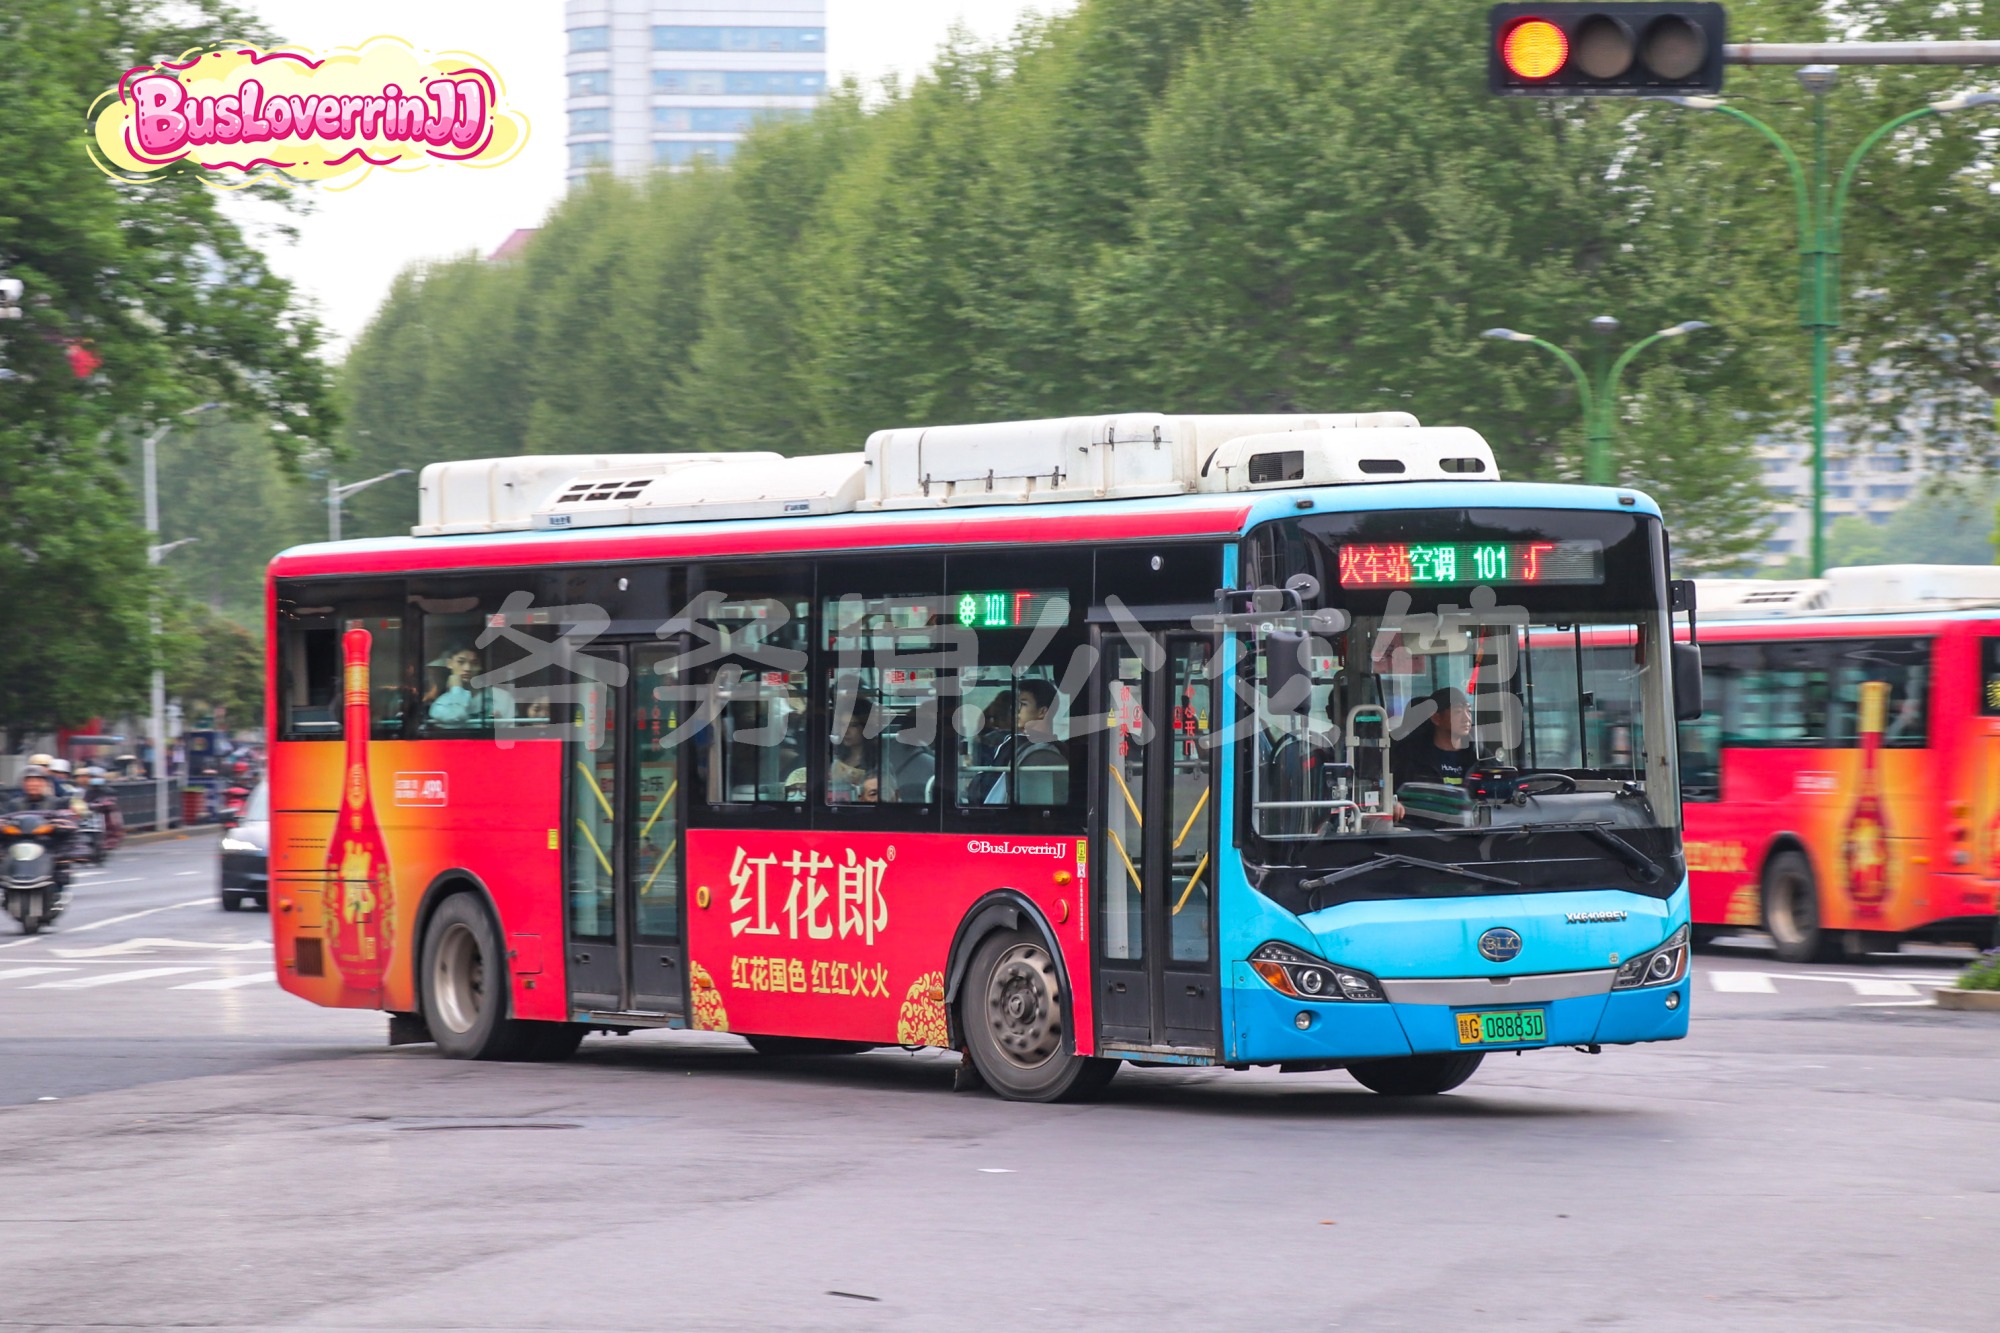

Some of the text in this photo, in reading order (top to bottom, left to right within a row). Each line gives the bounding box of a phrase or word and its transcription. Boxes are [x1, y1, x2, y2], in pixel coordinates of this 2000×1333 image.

[1474, 546, 1507, 579] 101
[984, 593, 1006, 625] 101
[729, 846, 889, 946] 红花郎
[731, 955, 890, 998] 红花国色 红红火火
